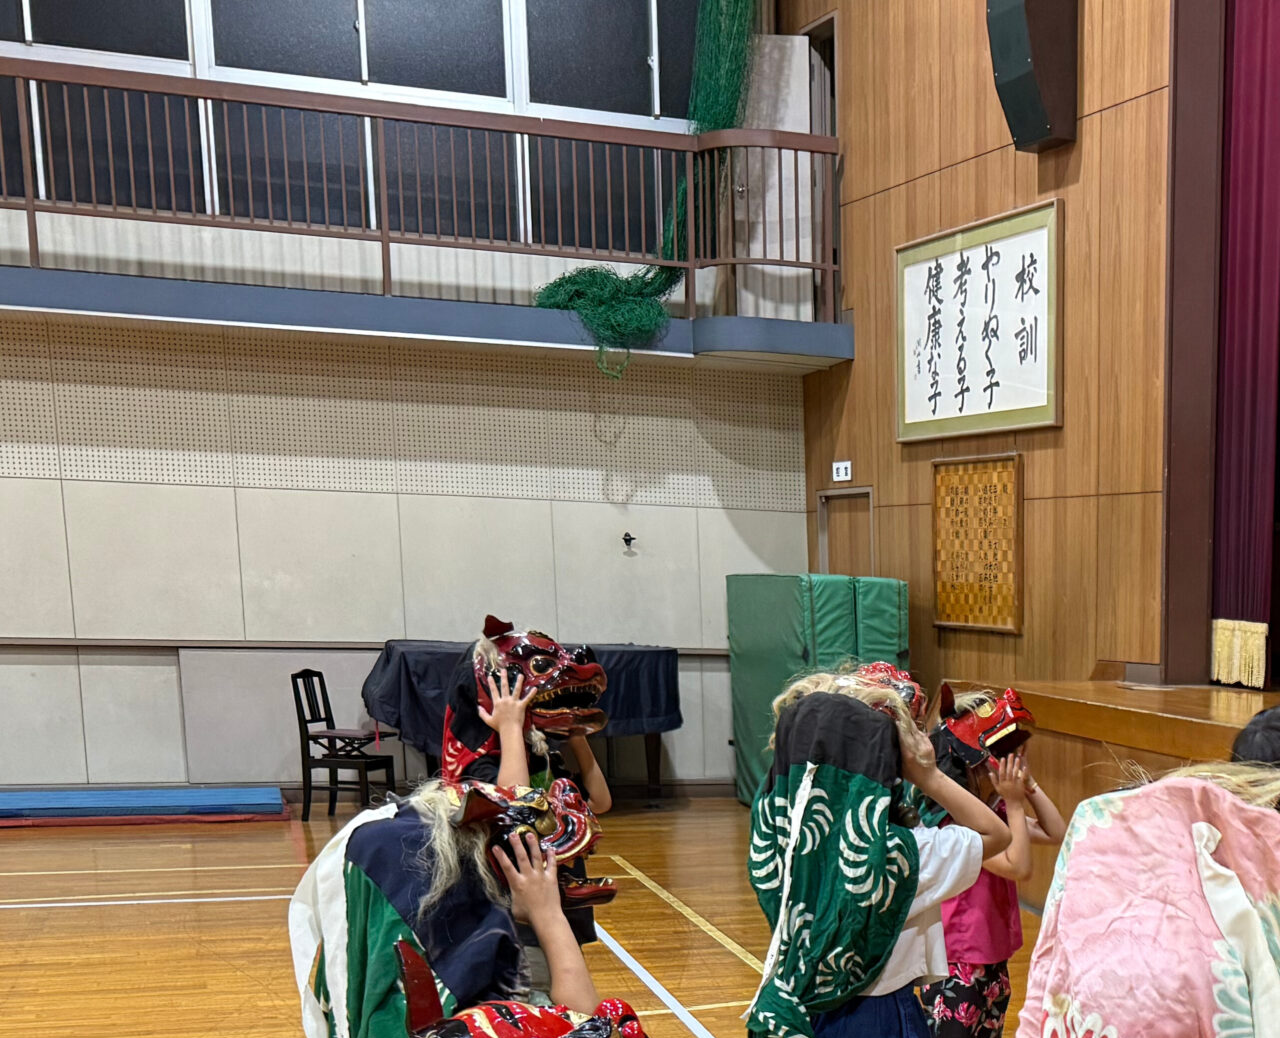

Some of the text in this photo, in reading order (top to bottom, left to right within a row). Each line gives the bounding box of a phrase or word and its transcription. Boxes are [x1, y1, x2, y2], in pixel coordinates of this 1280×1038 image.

[923, 258, 944, 416] 健康な子
[952, 250, 972, 414] 考える子
[981, 244, 1001, 410] やりぬく子
[1014, 252, 1041, 366] 校訓
